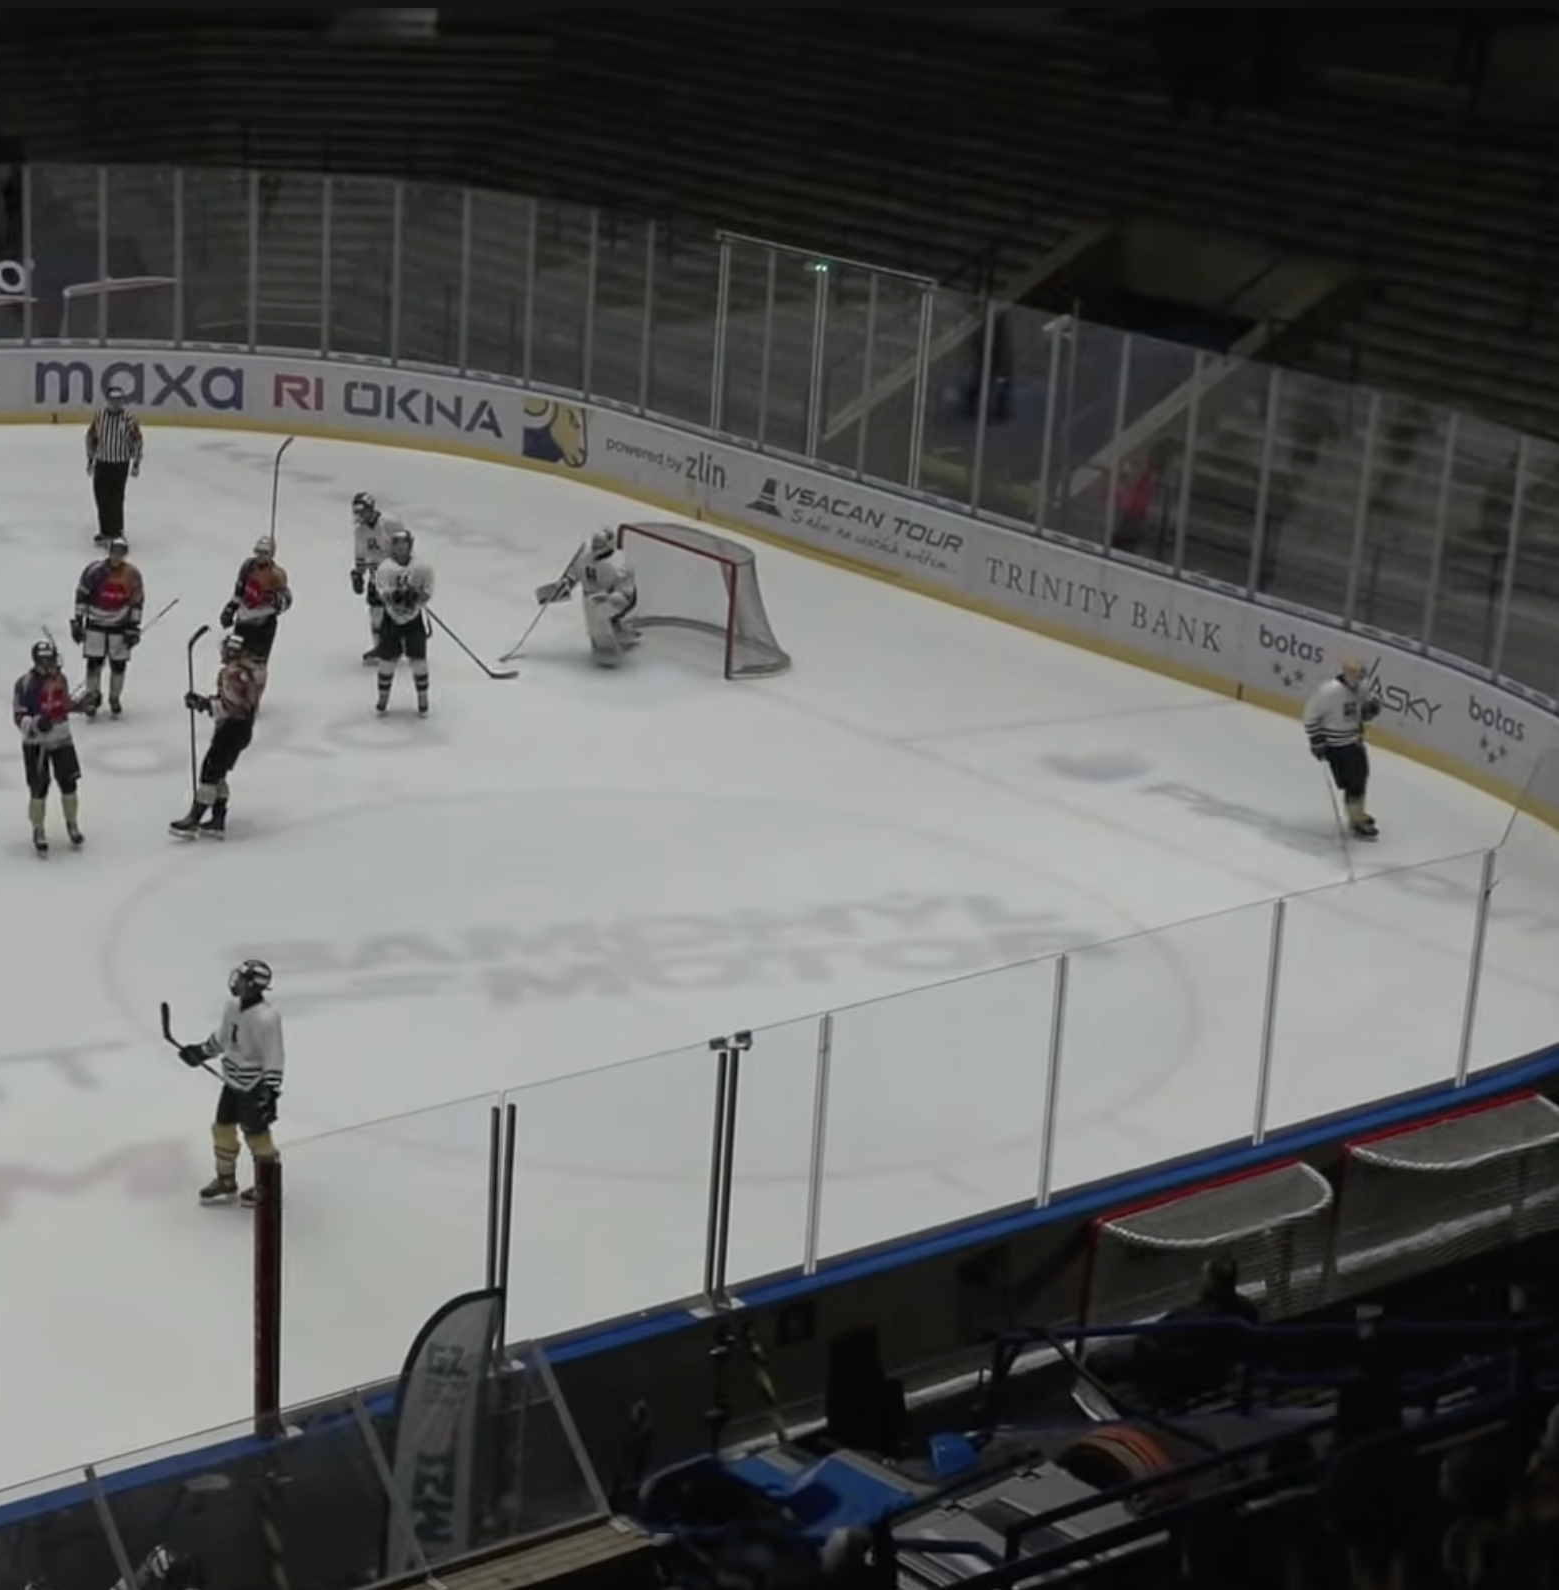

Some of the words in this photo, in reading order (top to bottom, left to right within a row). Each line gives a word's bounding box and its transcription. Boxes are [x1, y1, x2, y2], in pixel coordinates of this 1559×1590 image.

[35, 361, 245, 410] maxa
[274, 374, 324, 411] RI
[343, 381, 505, 439] OKNA
[606, 436, 664, 467] powered
[782, 483, 888, 529] VSACAN
[892, 517, 965, 554] TOUR
[985, 556, 1119, 620] TRINITY
[1130, 601, 1223, 652] BANK
[1259, 623, 1324, 664] botas
[1367, 656, 1443, 725] ASKY
[1468, 694, 1525, 742] botas
